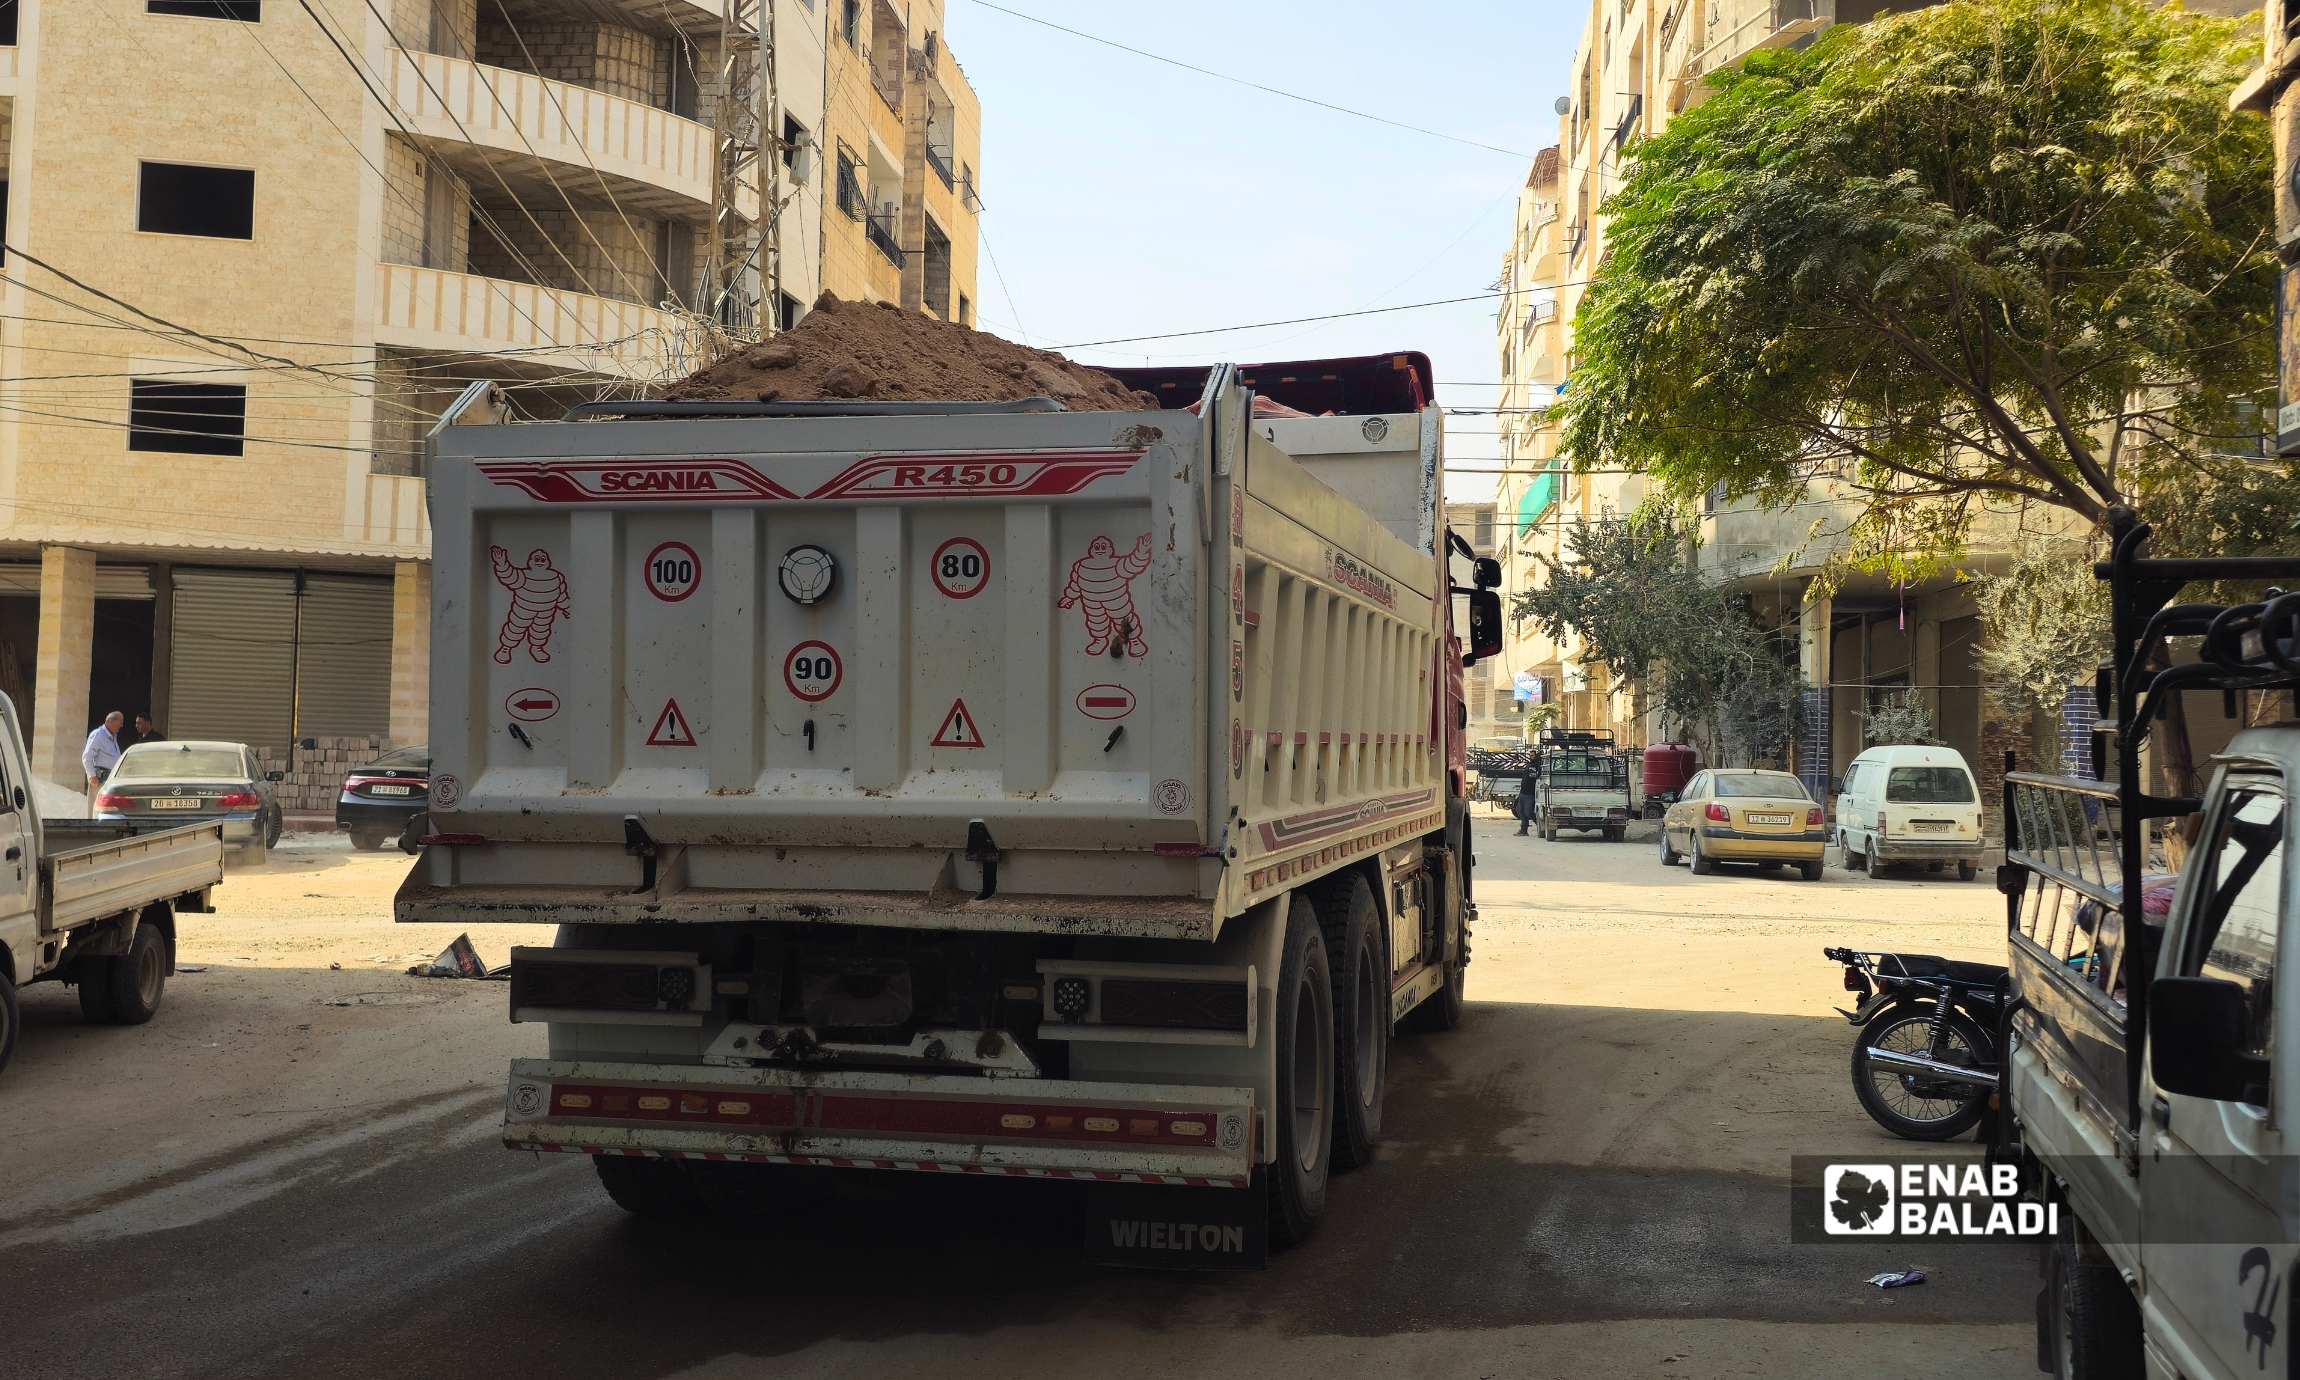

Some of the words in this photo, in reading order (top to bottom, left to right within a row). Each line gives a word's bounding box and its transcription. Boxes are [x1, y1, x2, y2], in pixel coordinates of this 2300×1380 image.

[601, 472, 717, 490] SCANIA
[894, 465, 1017, 486] R450
[653, 560, 692, 584] 100
[941, 555, 980, 578] 80
[664, 585, 680, 595] Km
[951, 581, 967, 592] Km
[1334, 552, 1394, 610] SCANIA
[795, 657, 832, 680] 90
[804, 683, 821, 694] Km
[154, 800, 164, 808] 20
[1751, 815, 1760, 823] 12
[1110, 1220, 1243, 1254] WIELTON
